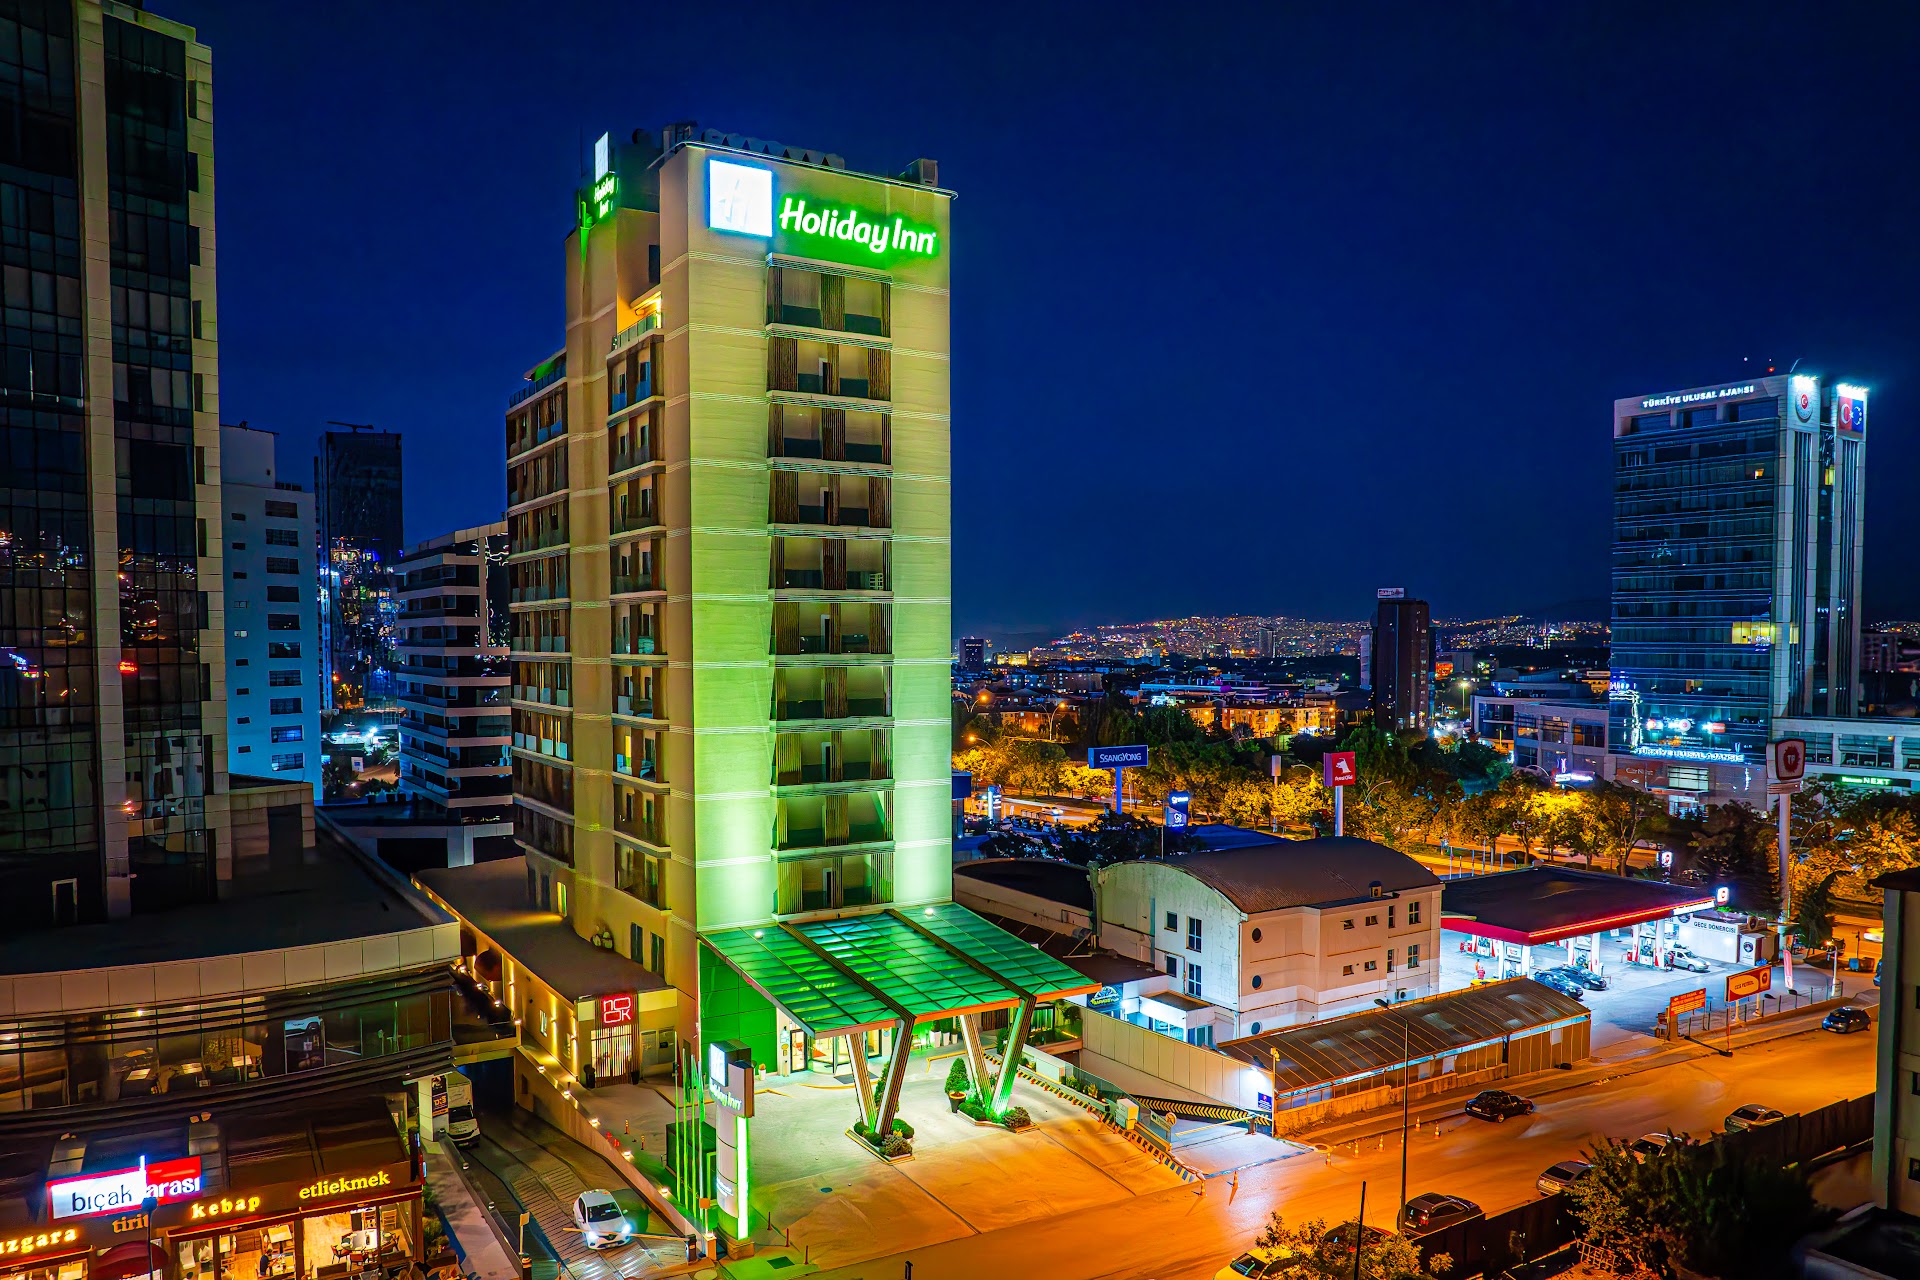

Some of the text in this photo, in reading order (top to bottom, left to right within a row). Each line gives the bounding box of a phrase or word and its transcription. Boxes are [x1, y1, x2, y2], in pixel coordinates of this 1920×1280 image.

[779, 198, 934, 254] Holiday Inn
[1643, 385, 1754, 408] TÜRKİYE ULUSAL AJANSI
[1863, 777, 1891, 785] NEXT
[72, 1176, 201, 1212] bıçak arası
[299, 1171, 390, 1199] etliekmek
[191, 1196, 261, 1218] kebap
[112, 1213, 149, 1233] tirit
